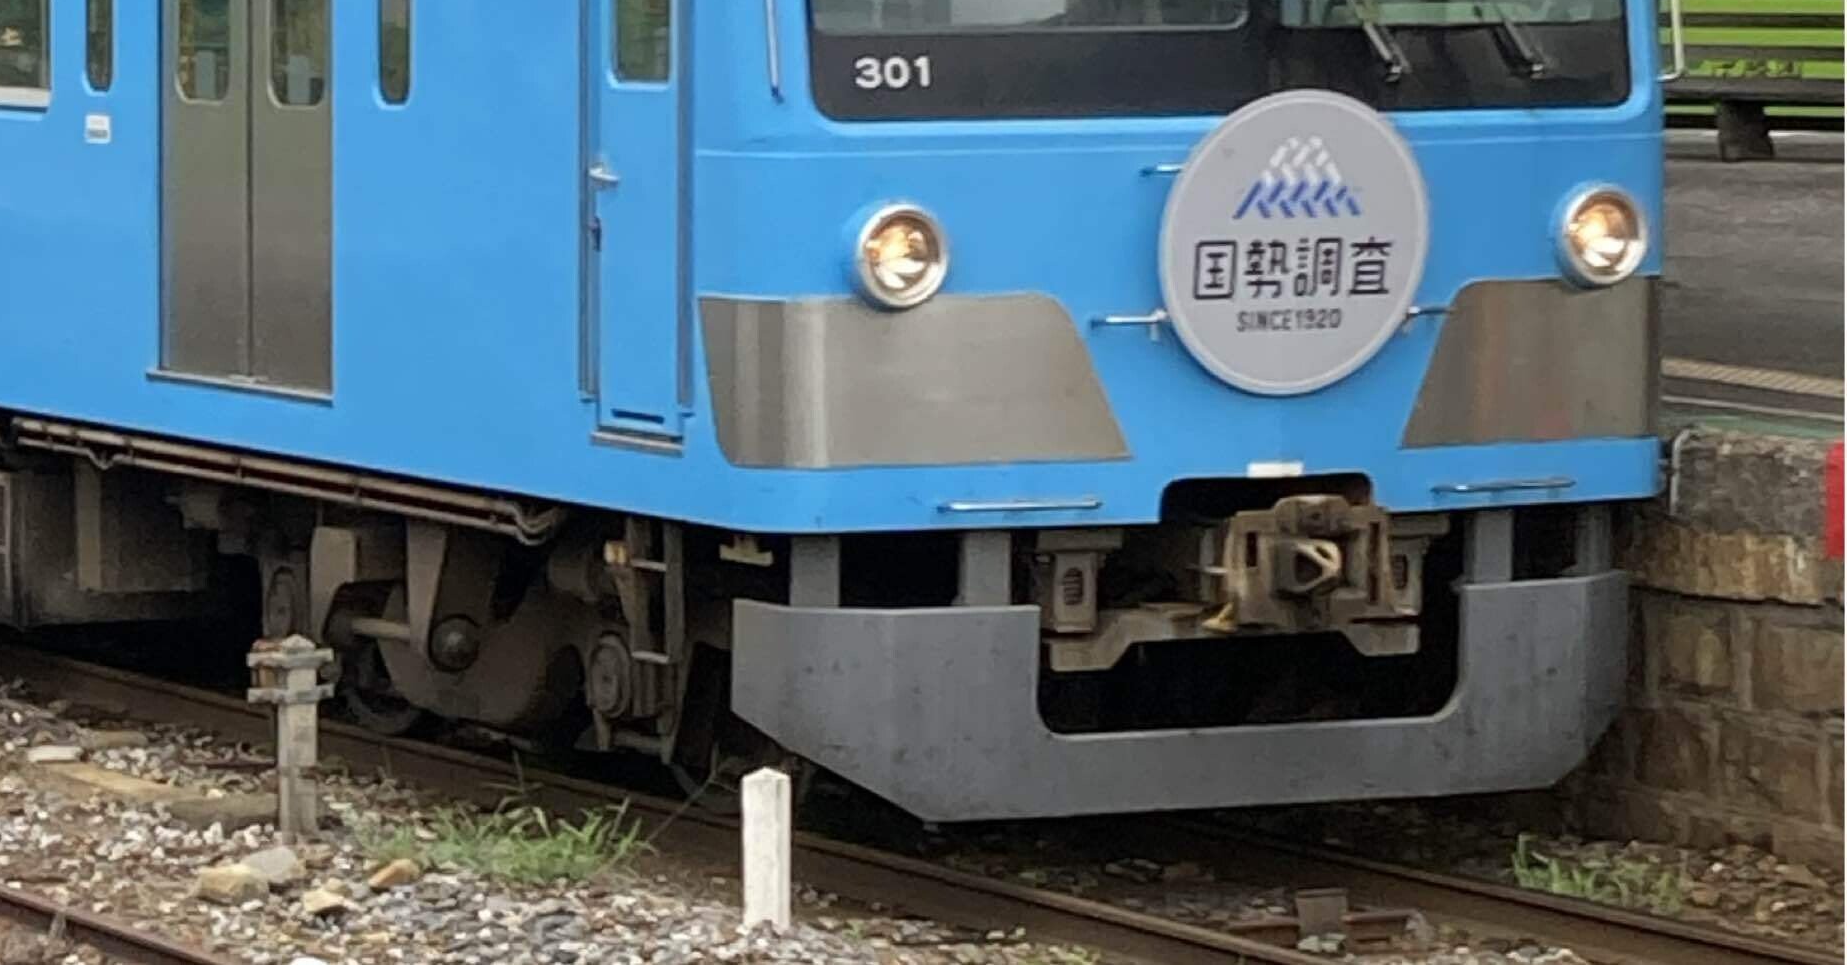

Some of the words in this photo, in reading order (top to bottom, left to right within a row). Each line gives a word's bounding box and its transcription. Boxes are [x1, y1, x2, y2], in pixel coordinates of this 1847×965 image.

[855, 56, 931, 88] 301
[1193, 236, 1393, 300] 国勢調査
[1236, 310, 1291, 332] SINCE
[1294, 307, 1342, 329] 1920
